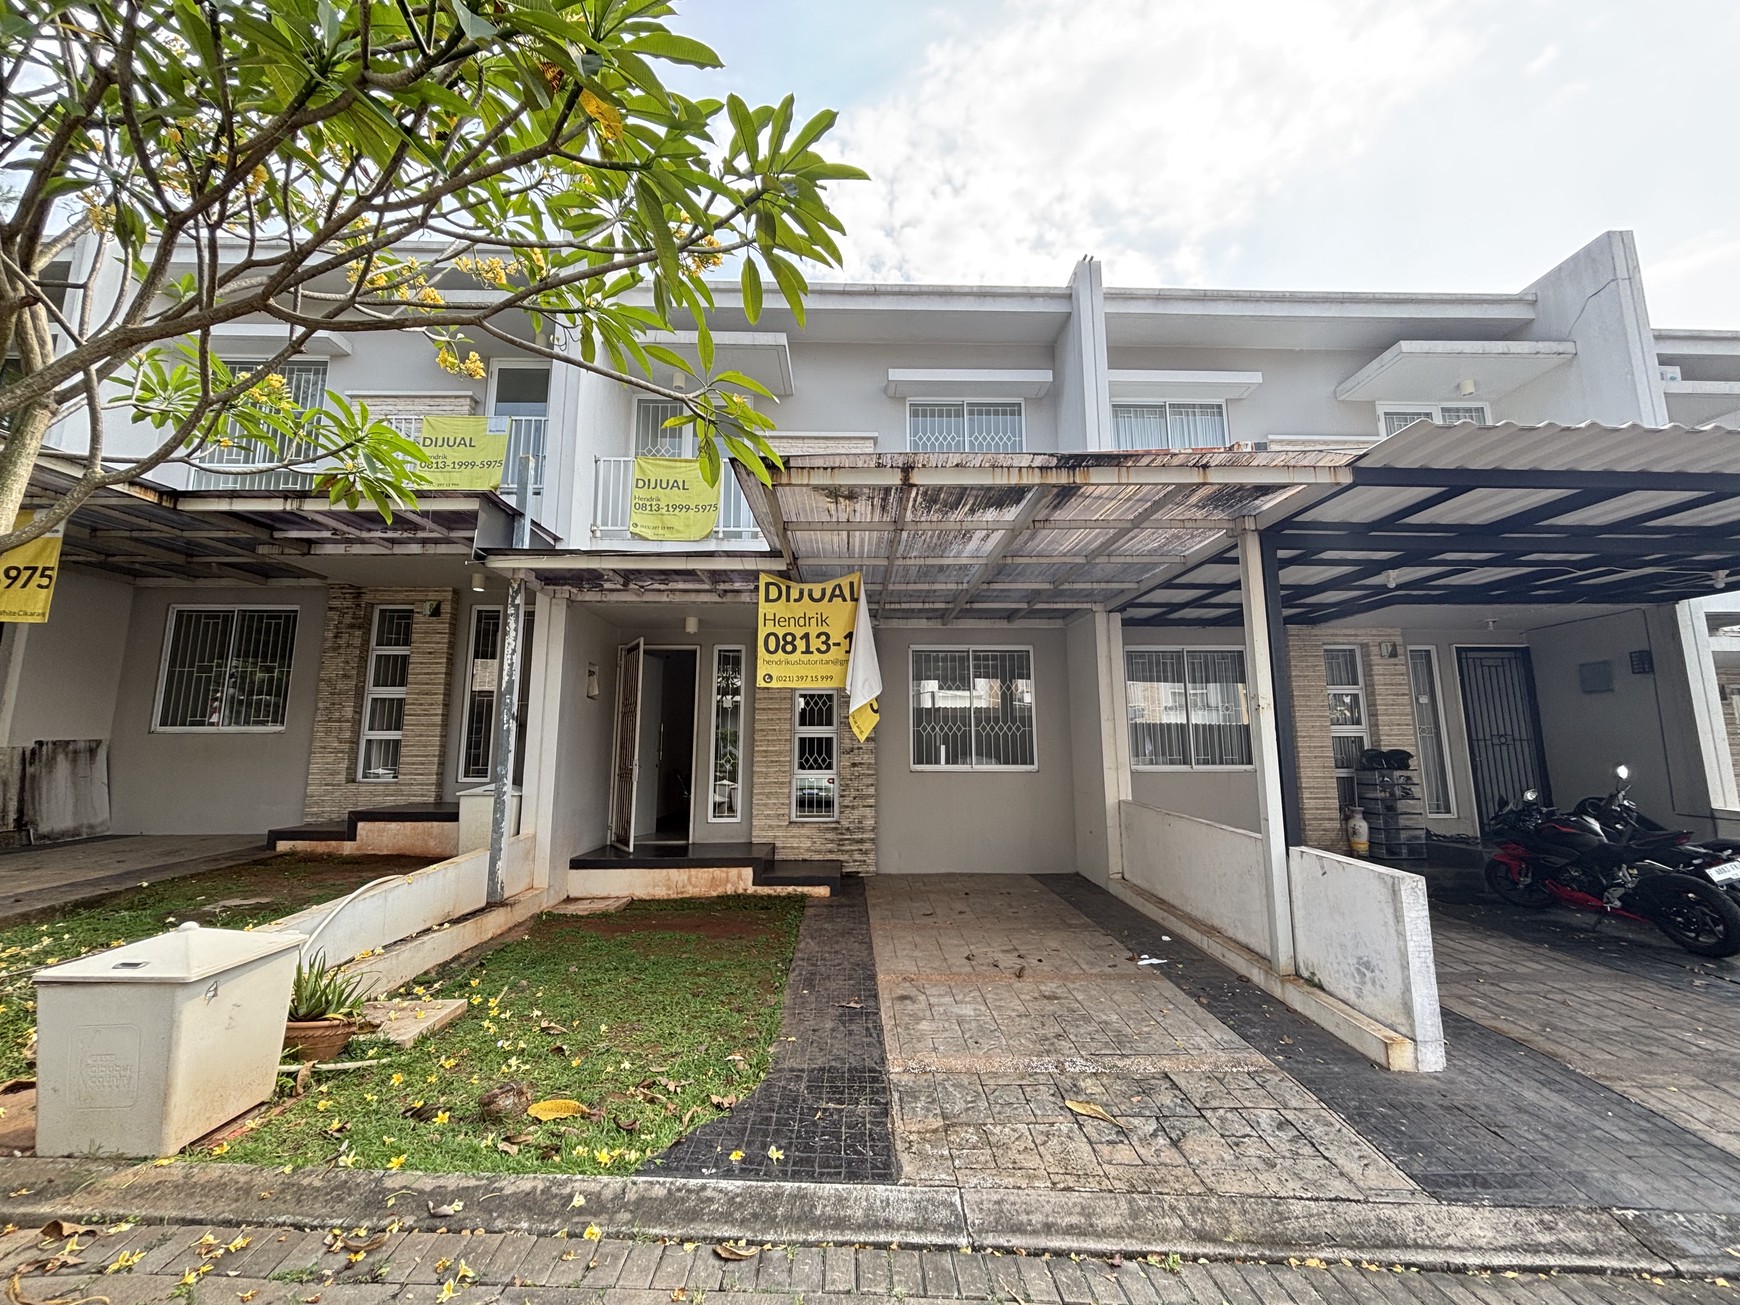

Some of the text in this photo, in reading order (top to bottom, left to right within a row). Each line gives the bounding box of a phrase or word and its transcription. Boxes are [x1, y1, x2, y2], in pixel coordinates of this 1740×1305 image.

[421, 436, 476, 448] DIJUAL
[419, 460, 503, 470] 0813-1999-5975
[635, 478, 690, 491] DIJUAL
[633, 502, 719, 513] 0813-1999-5975
[0, 565, 55, 590] 975
[763, 581, 859, 603] DIJUAL
[763, 612, 830, 628] Hendrik
[775, 674, 795, 683] (021)
[810, 674, 819, 682] 15
[820, 674, 834, 682] 999
